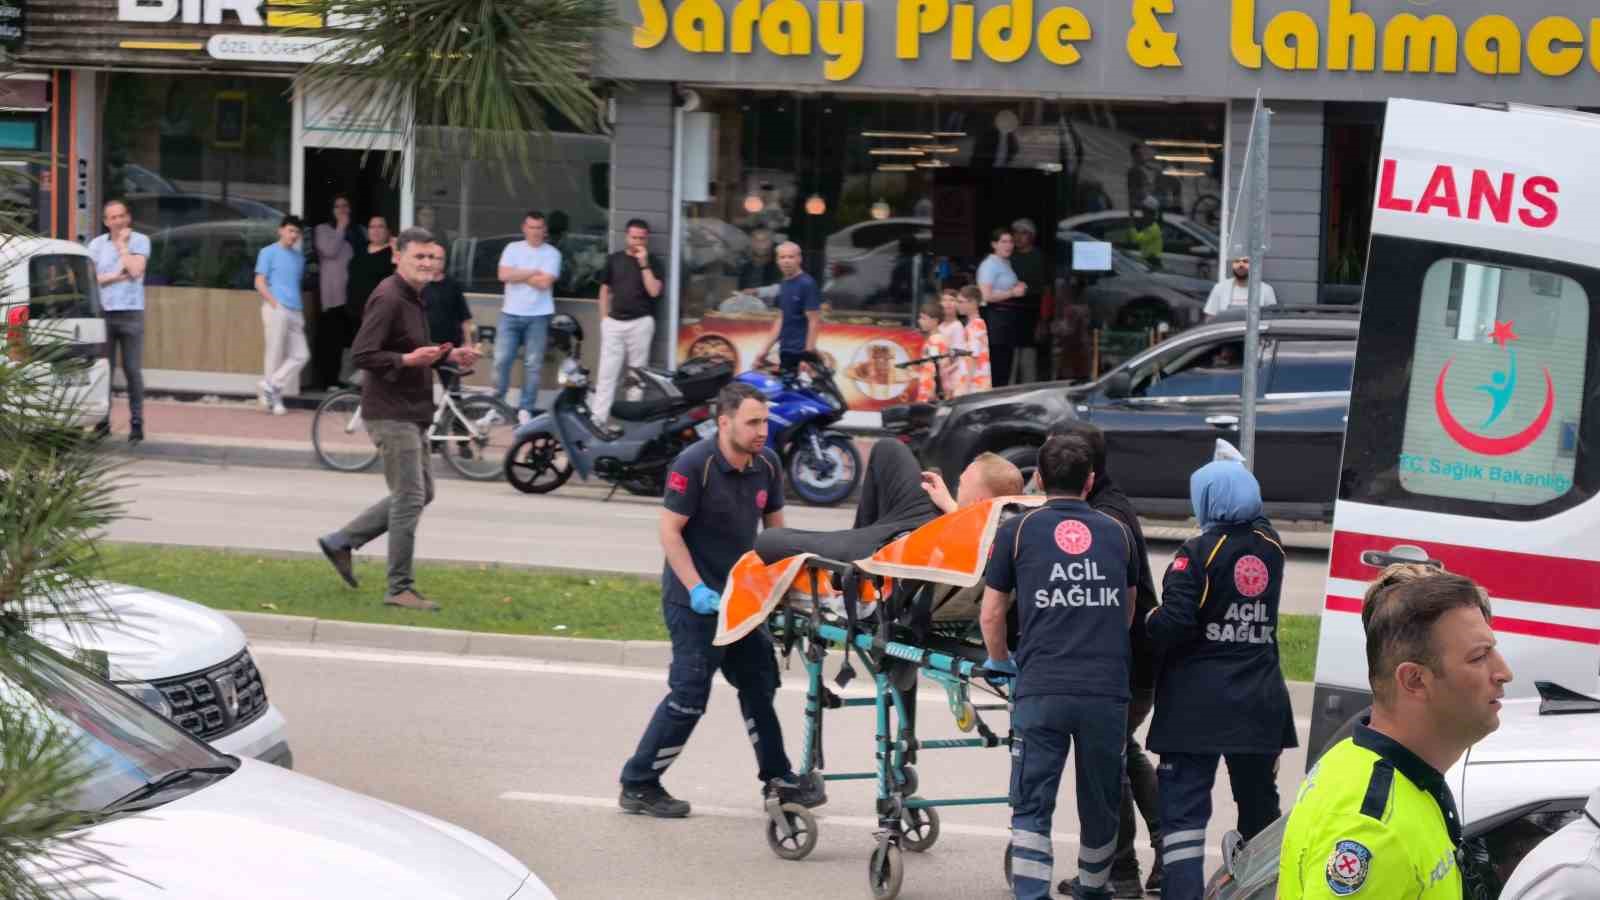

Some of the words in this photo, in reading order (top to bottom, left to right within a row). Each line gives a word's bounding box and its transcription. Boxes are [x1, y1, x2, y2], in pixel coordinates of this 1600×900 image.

[631, 0, 865, 82] Saray
[895, 0, 1092, 66] Pide
[1126, 0, 1184, 69] &
[1229, 0, 1600, 77] Lahmac
[1377, 159, 1561, 230] LANS
[1428, 457, 1480, 481] Sağlık
[1048, 558, 1107, 582] ACİL
[1034, 584, 1121, 609] SAĞLIK
[1205, 620, 1275, 645] SAĞLIK
